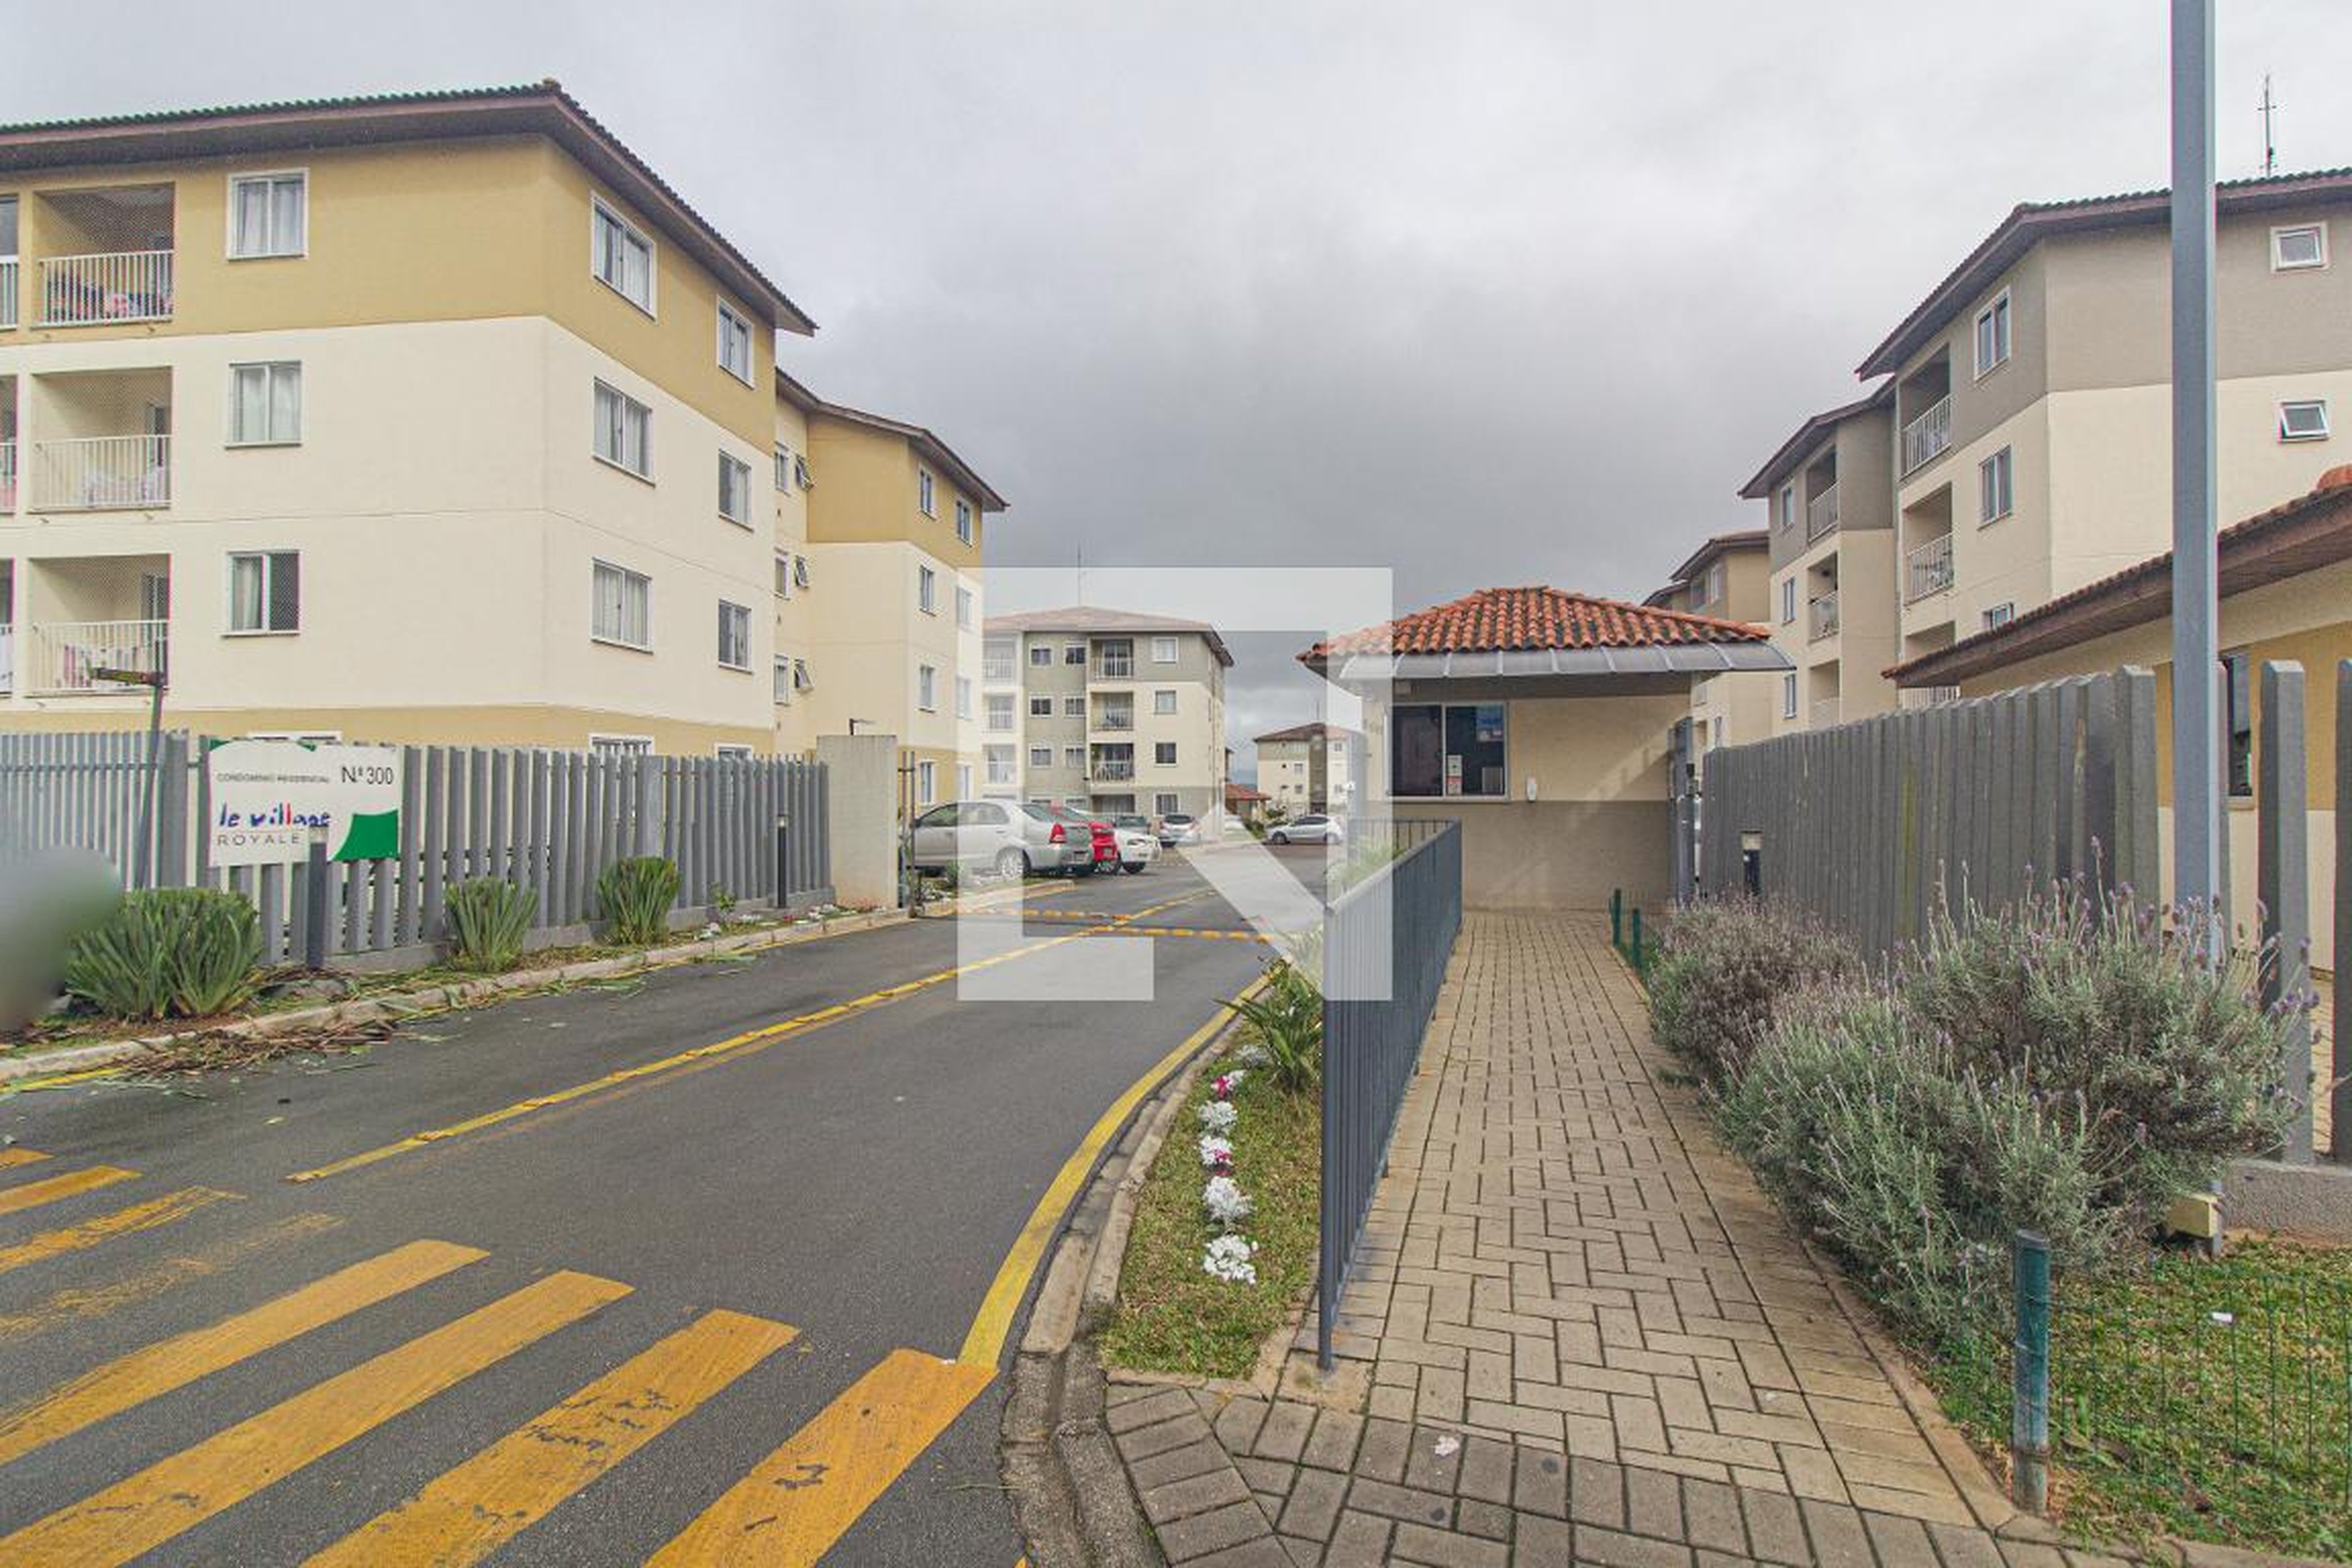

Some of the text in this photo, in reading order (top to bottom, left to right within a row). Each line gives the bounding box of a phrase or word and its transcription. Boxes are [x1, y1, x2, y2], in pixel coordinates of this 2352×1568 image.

[367, 767, 393, 785] 300
[220, 802, 240, 827] le
[217, 832, 300, 846] ROYALE
